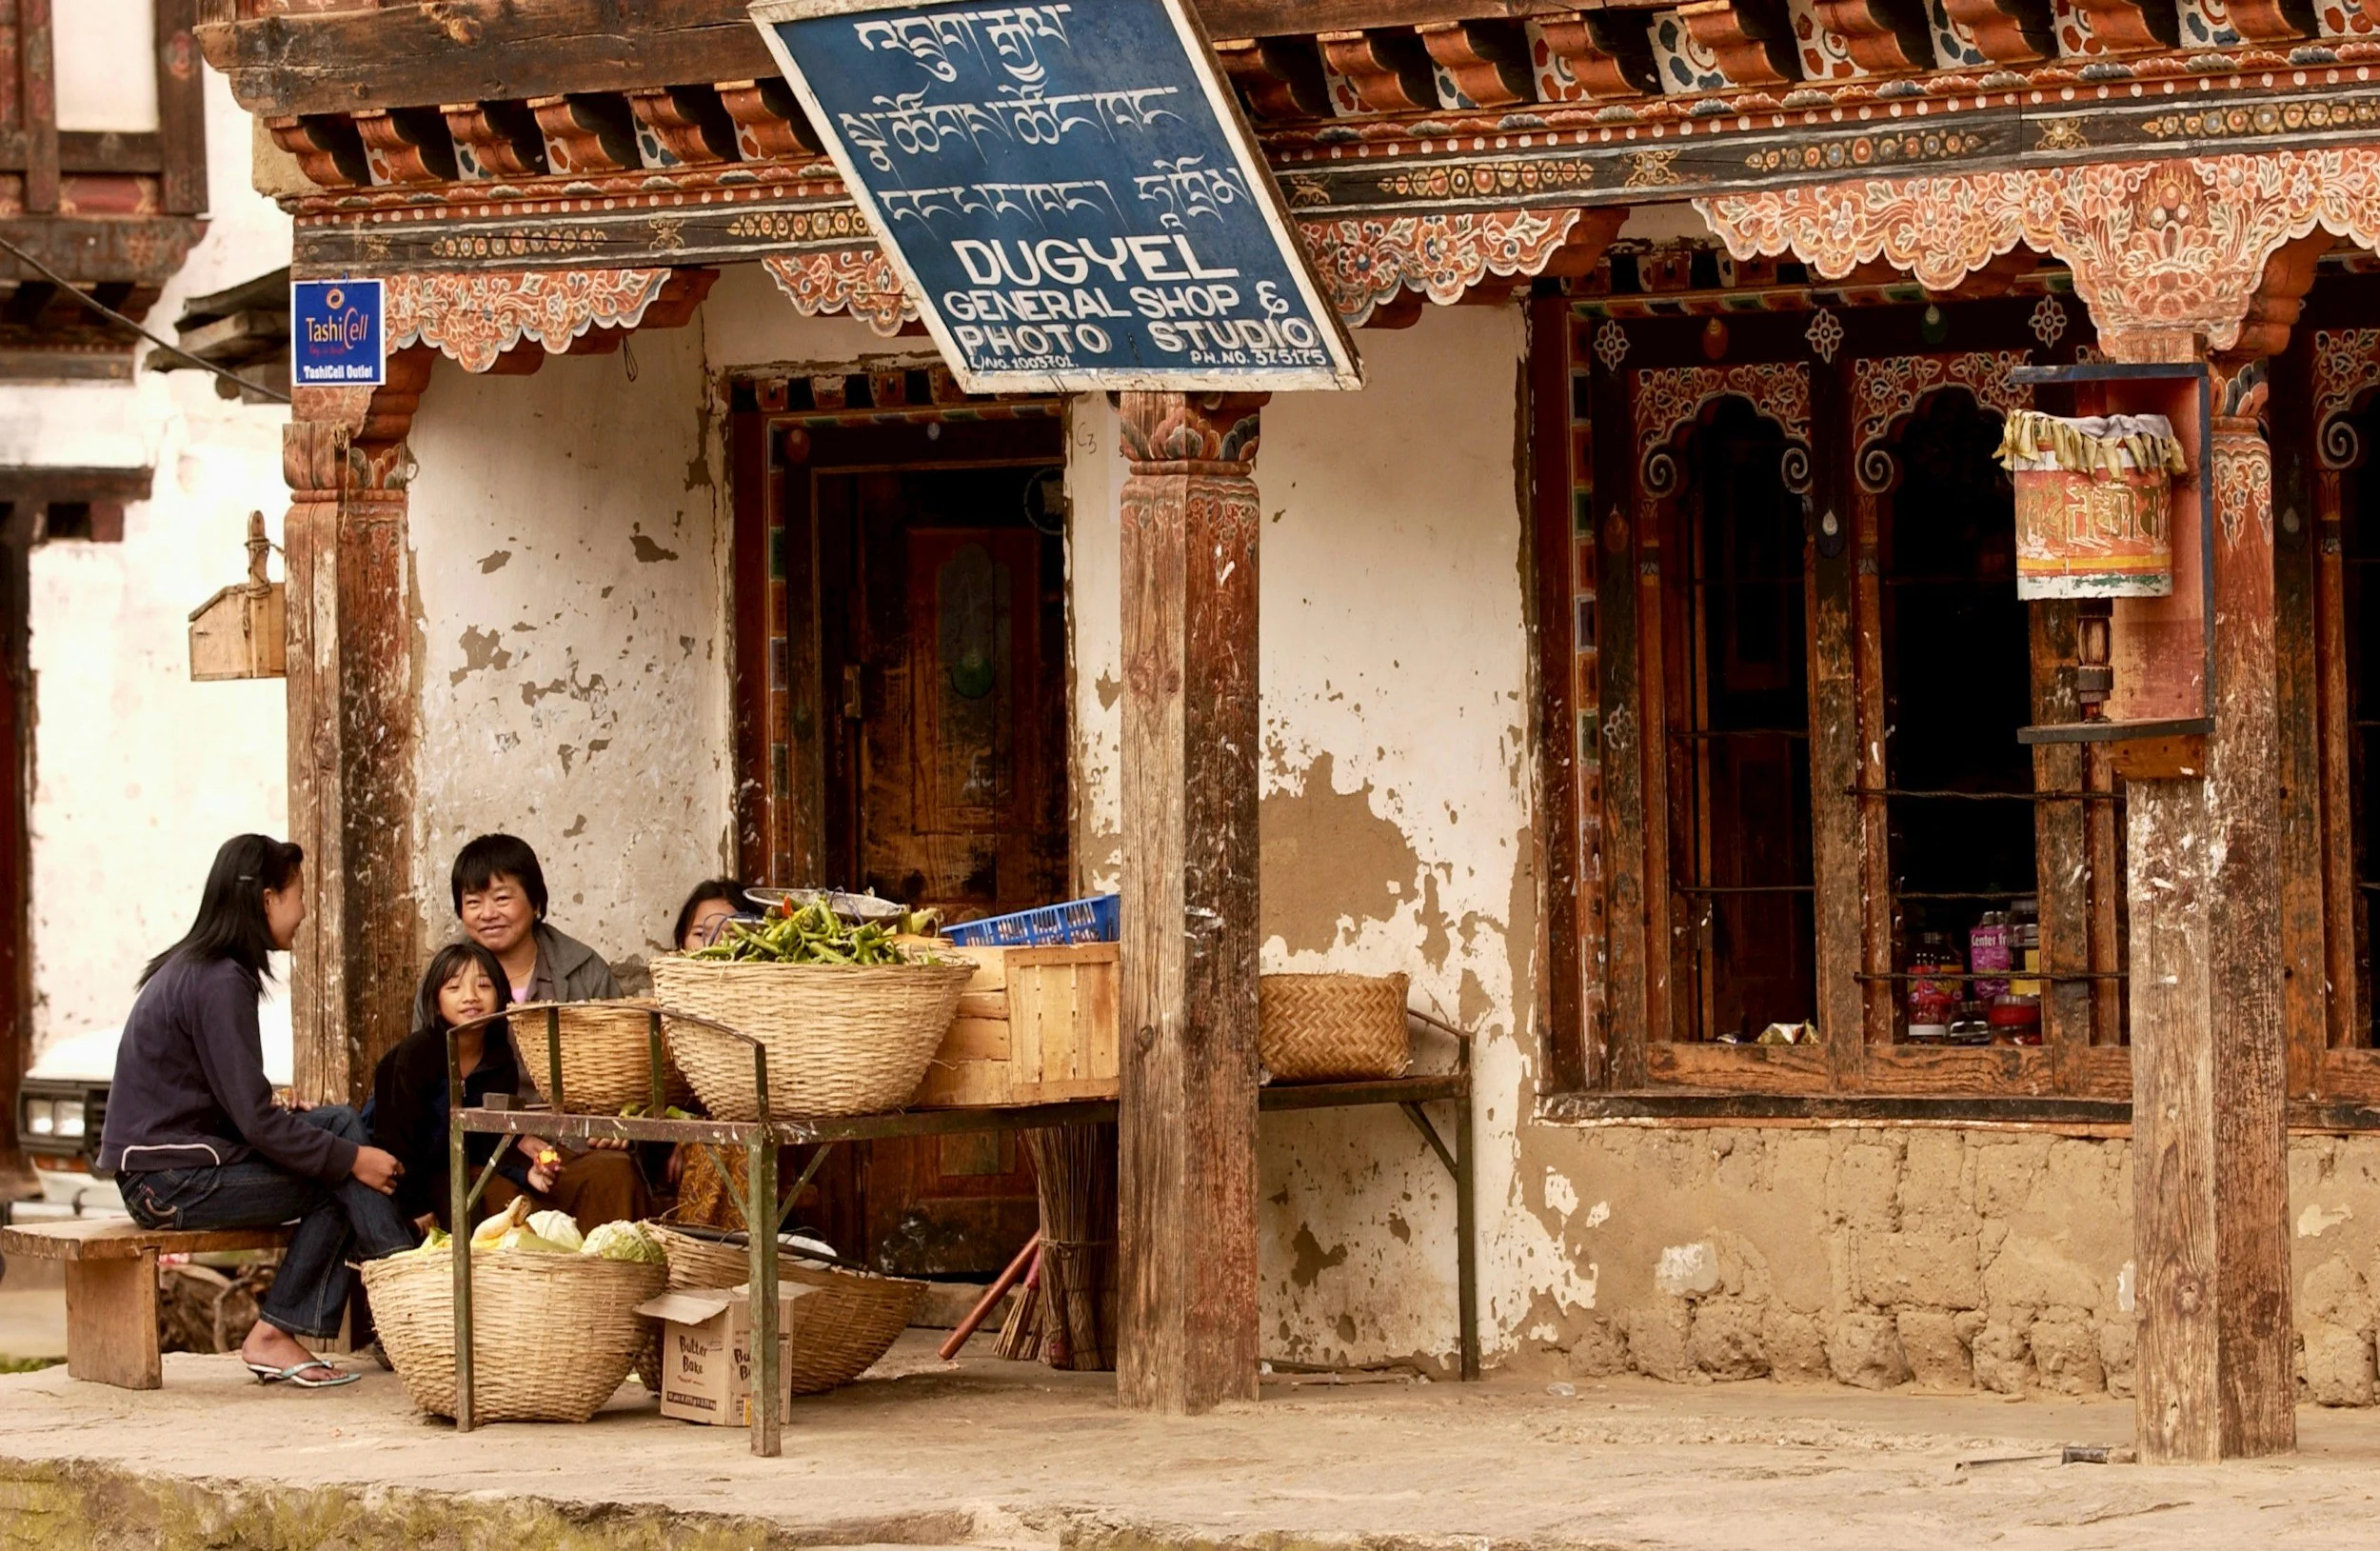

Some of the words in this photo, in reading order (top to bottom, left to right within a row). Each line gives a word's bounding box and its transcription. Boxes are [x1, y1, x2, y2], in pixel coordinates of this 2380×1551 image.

[951, 233, 1240, 287] DUGYEL
[943, 288, 1133, 322] GENERAL
[1130, 285, 1240, 320] SHOP
[1256, 280, 1290, 322] &
[306, 307, 369, 350] TashiCell
[953, 322, 1112, 358] PHOTO
[1147, 317, 1321, 354] STUDIO
[304, 366, 345, 379] TashiCell
[347, 365, 372, 378] Outlet
[1972, 933, 1996, 946] Center
[680, 1335, 707, 1357] Butter
[684, 1356, 703, 1375] Bake
